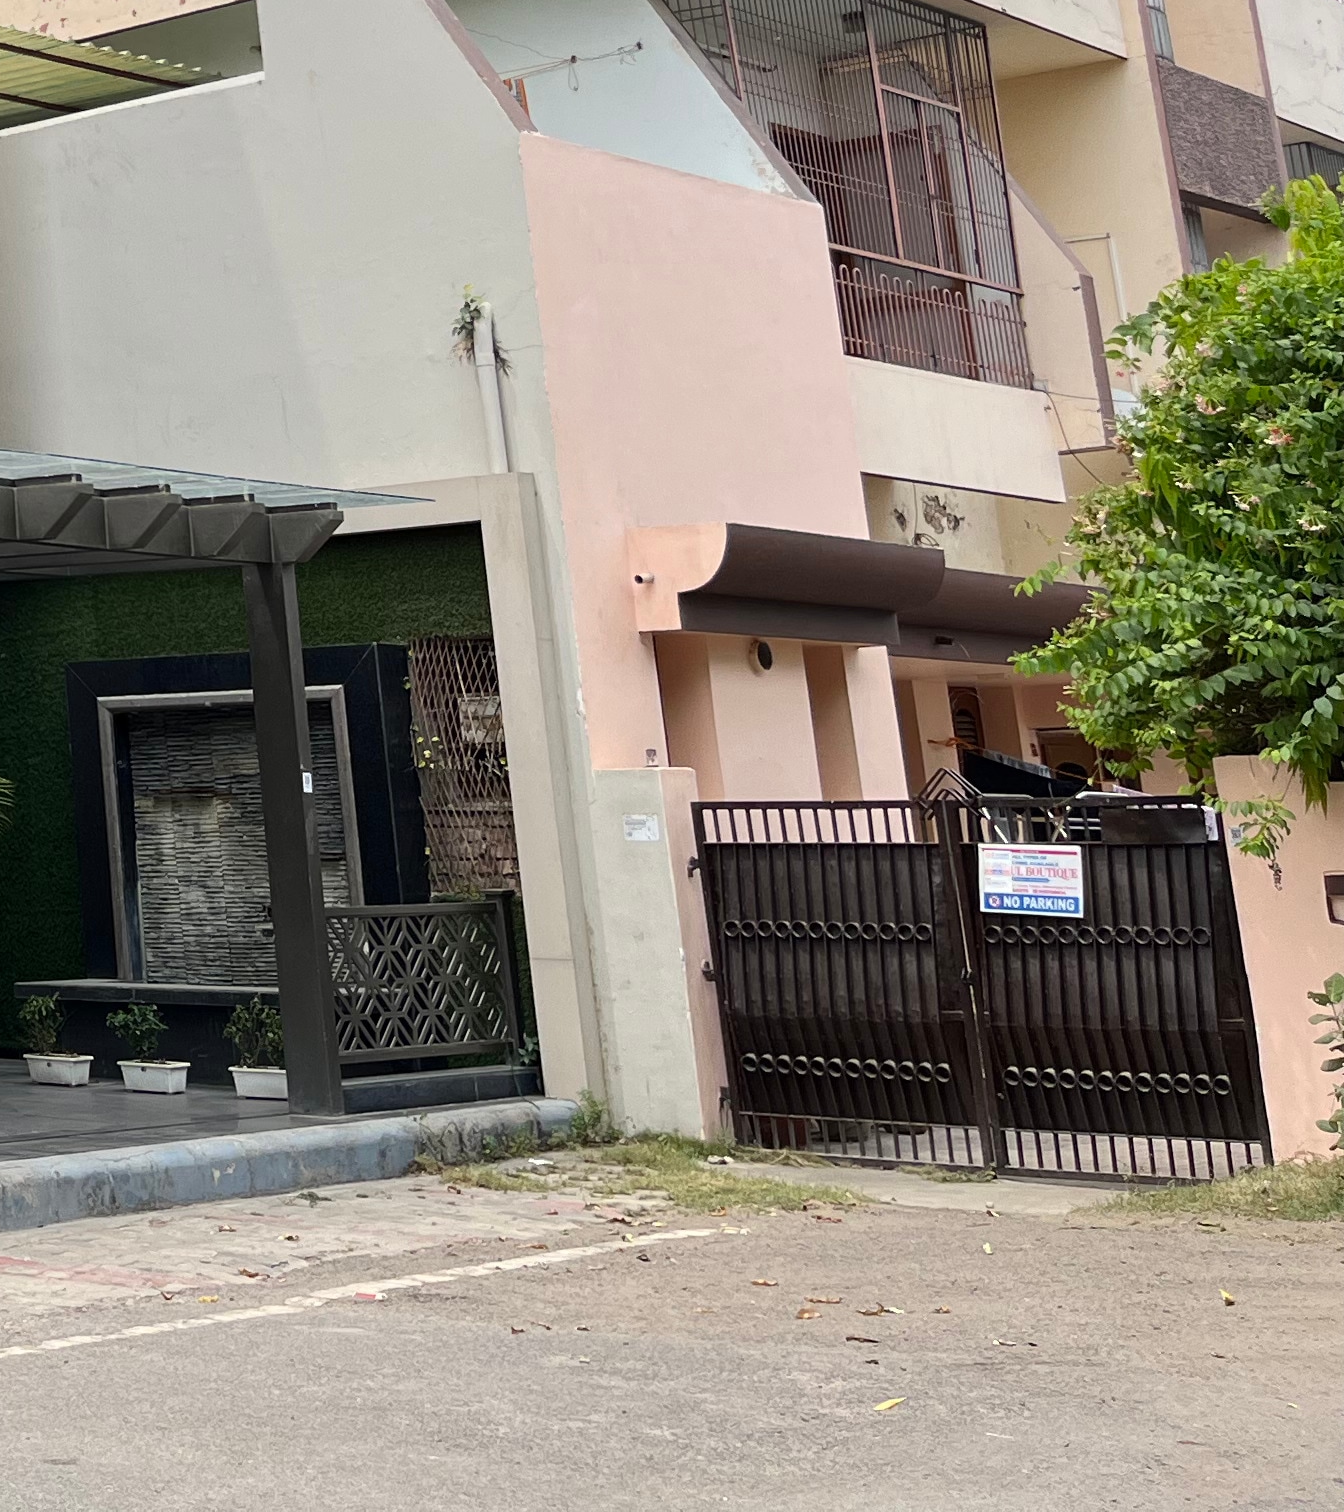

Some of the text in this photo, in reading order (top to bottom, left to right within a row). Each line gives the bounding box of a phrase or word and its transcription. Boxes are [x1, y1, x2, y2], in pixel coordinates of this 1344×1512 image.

[1025, 867, 1078, 880] BOUTIQUE
[1003, 895, 1076, 911] NO PARKING
